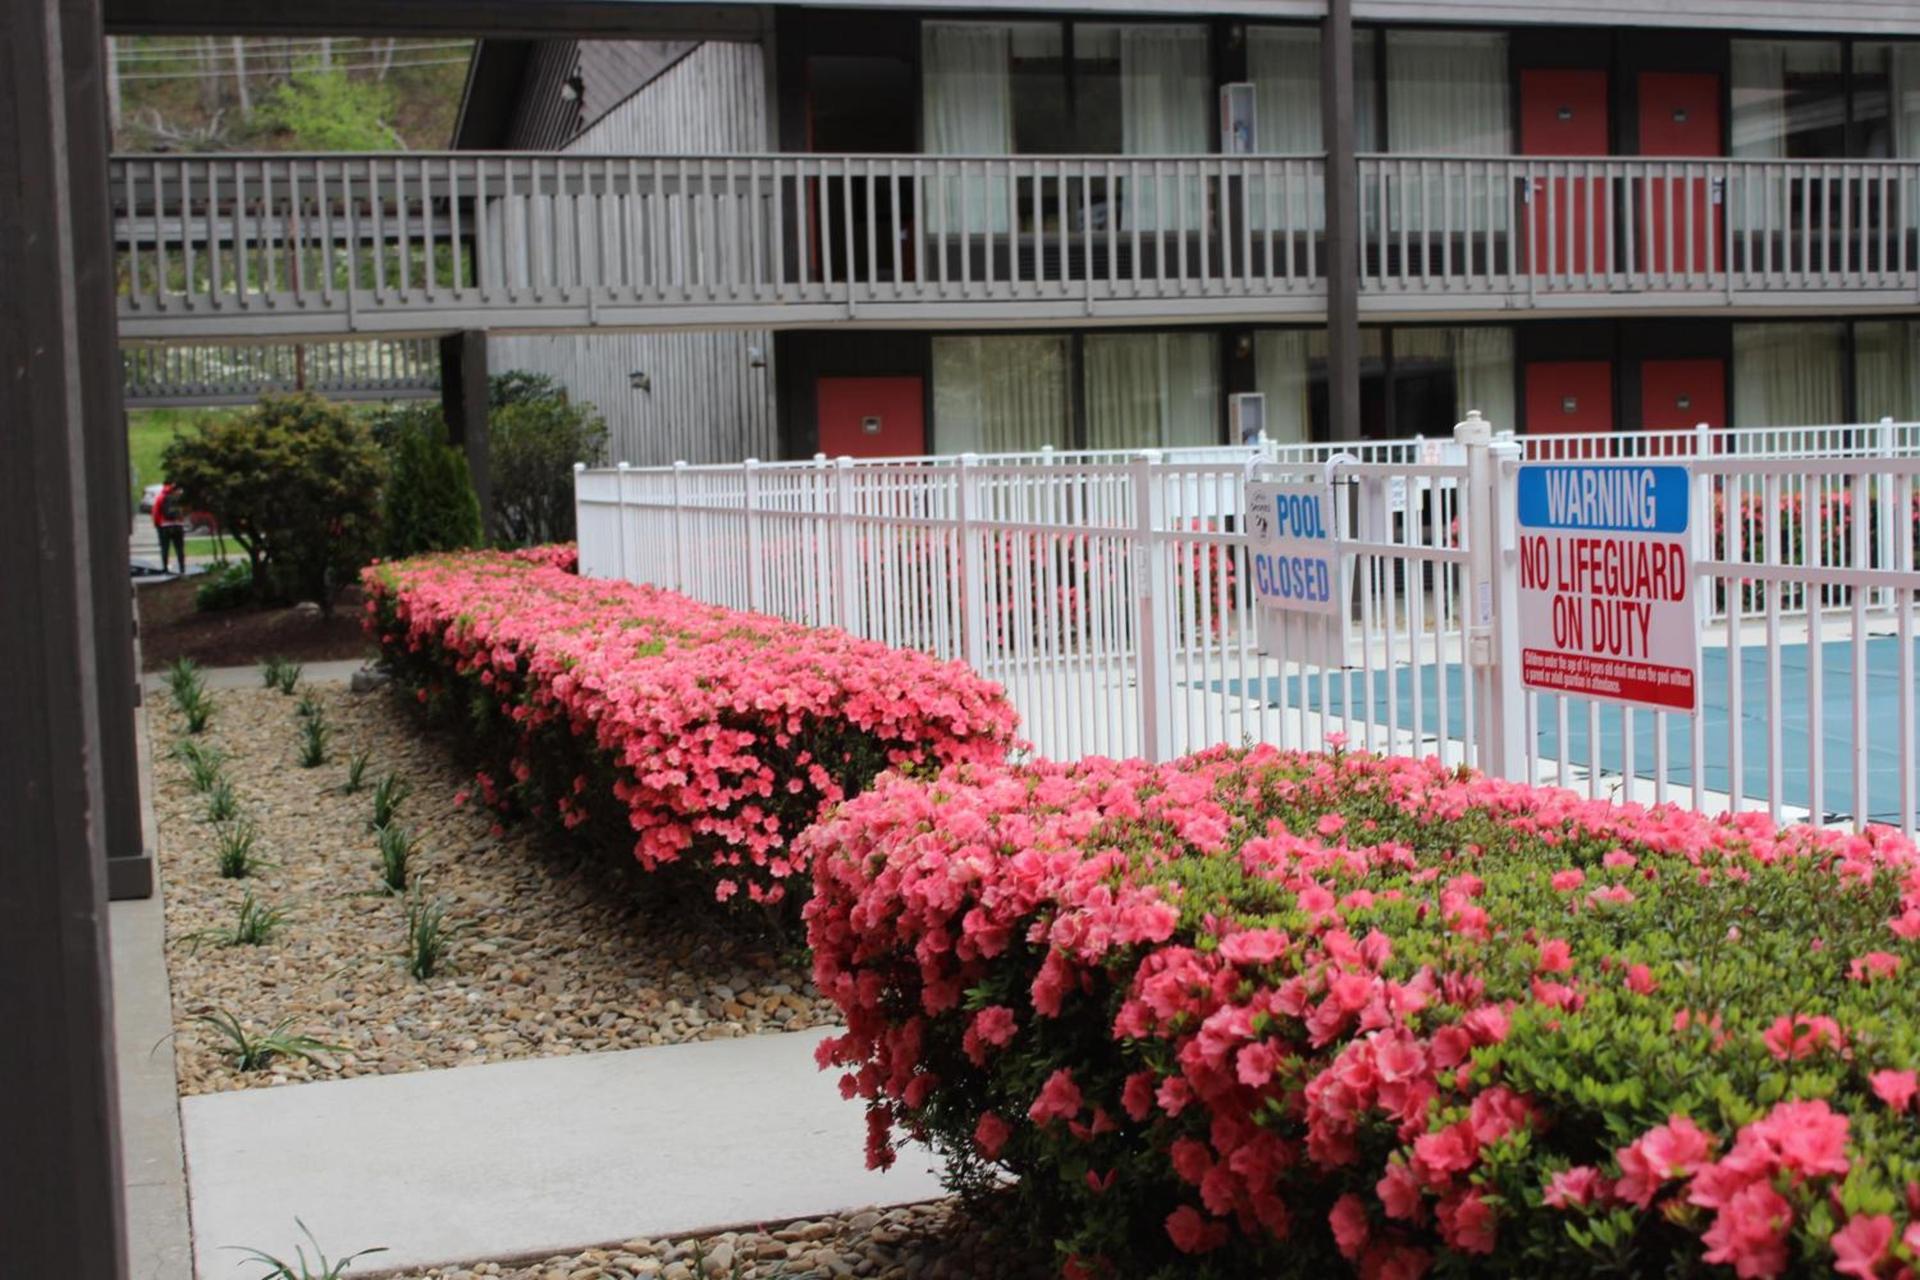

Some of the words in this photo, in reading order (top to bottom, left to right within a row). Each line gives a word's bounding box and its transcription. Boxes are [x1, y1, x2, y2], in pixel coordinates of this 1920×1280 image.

[1276, 494, 1326, 539] POOL
[1546, 468, 1656, 529] WARNING
[1255, 553, 1330, 603] CLOSED
[1520, 535, 1550, 591] NO
[1556, 537, 1686, 602] LIFEGUARD
[1553, 594, 1583, 651] ON
[1591, 598, 1651, 659] DUTY
